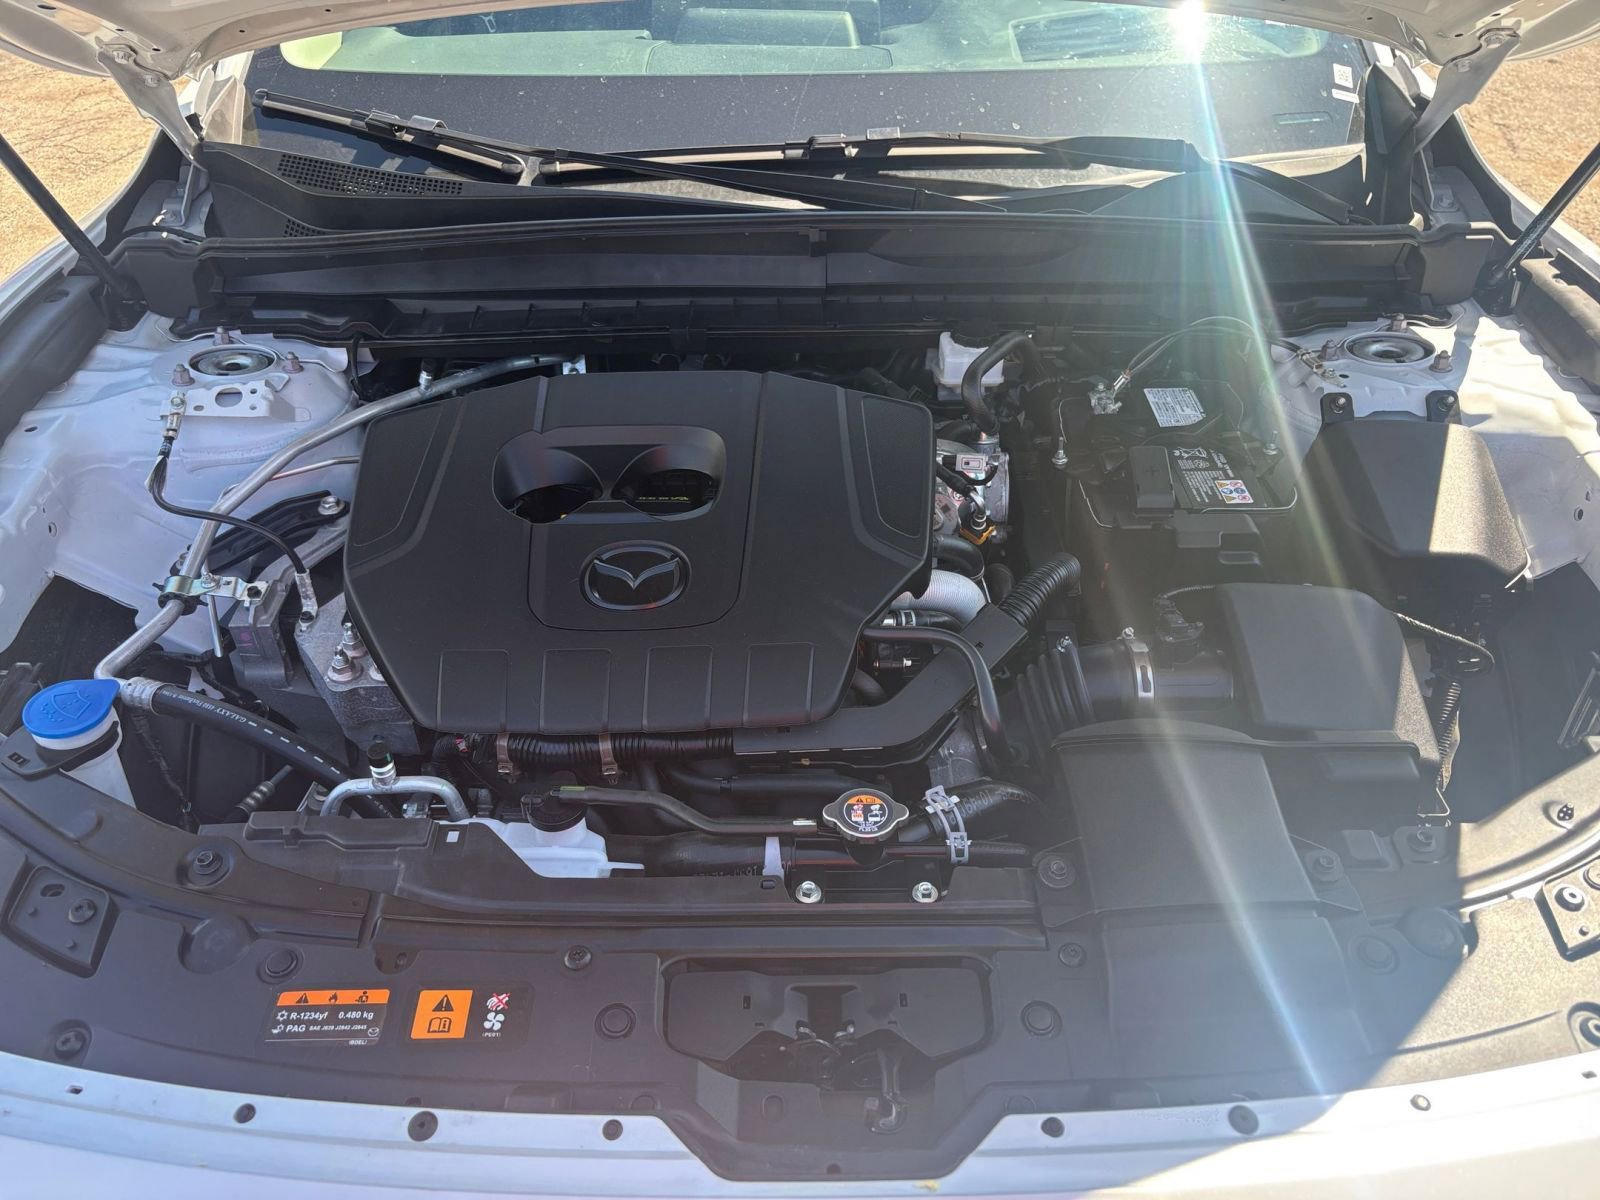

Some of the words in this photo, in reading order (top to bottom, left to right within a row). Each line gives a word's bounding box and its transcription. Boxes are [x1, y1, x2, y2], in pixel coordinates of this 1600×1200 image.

[289, 1011, 329, 1021] R-1234yf
[338, 1011, 361, 1020] 0.480
[362, 1010, 374, 1021] kg
[285, 1024, 306, 1033] PAG
